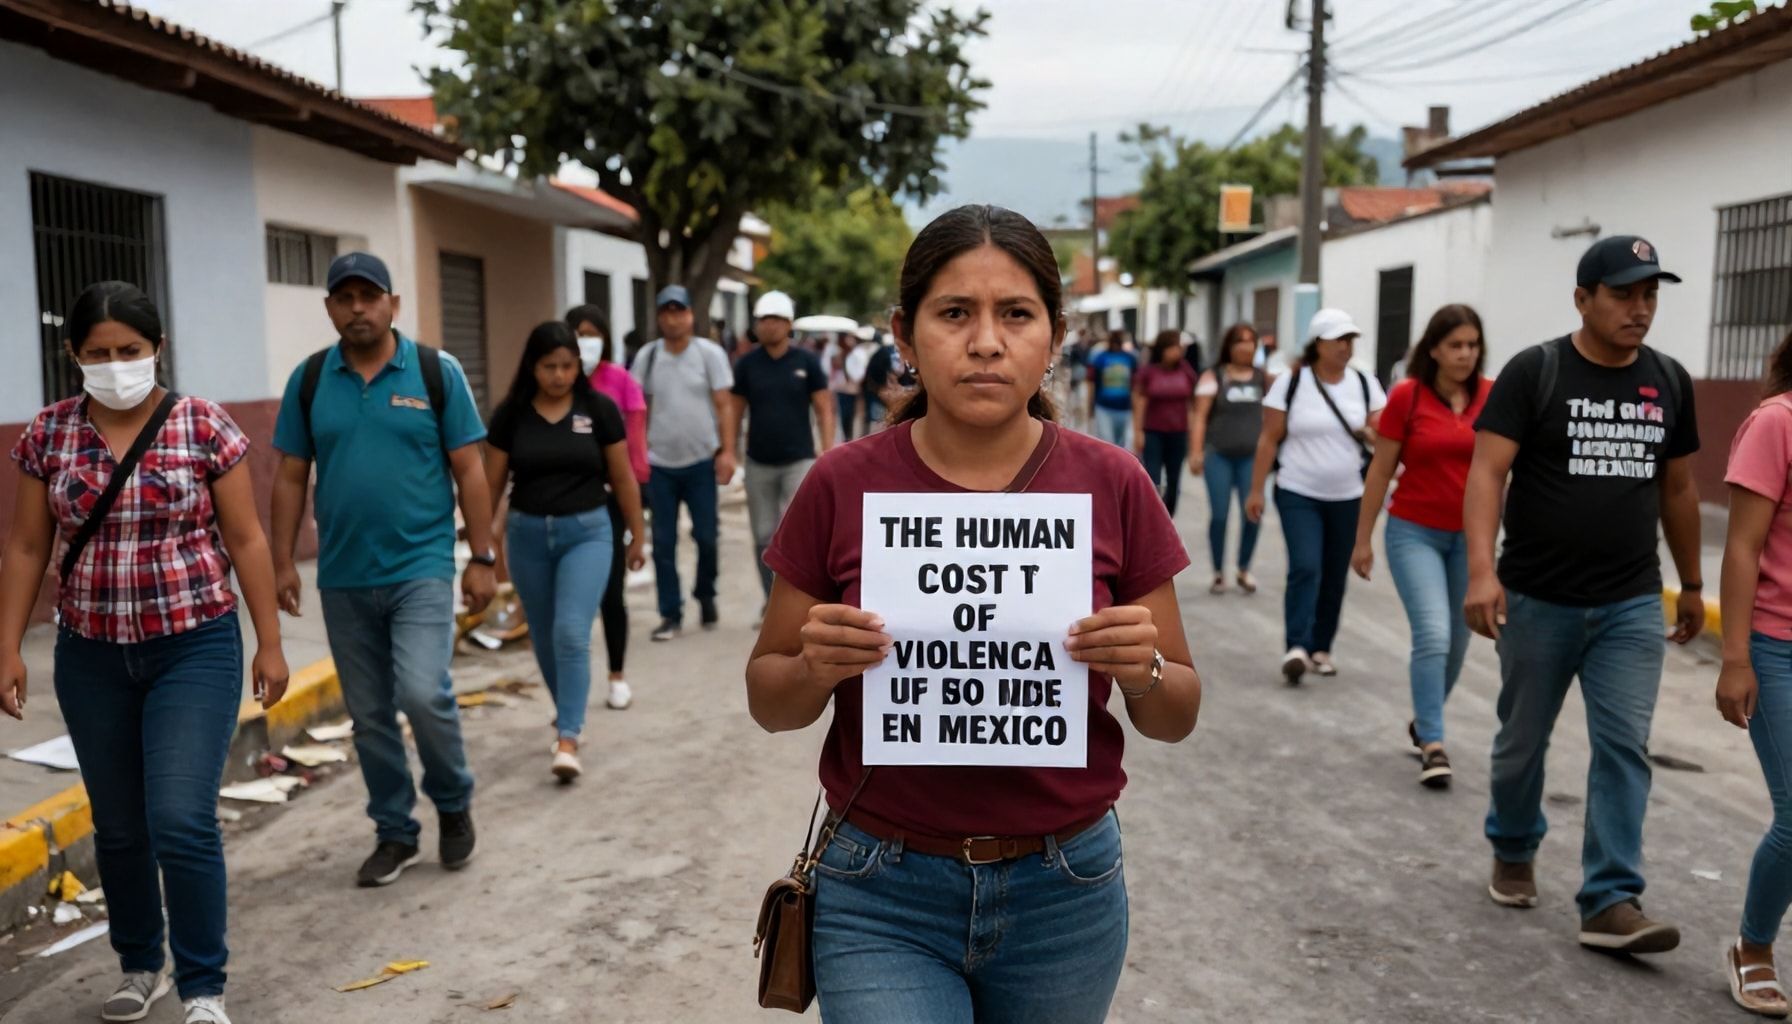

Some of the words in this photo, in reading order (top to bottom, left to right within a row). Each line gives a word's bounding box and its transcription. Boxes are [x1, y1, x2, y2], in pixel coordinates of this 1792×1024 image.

[880, 516, 943, 549] THE
[956, 517, 1075, 549] HUMAN
[918, 563, 1009, 595] COST
[953, 603, 997, 632] OF
[893, 640, 1056, 670] VIOLENCA
[890, 677, 928, 705] UF
[882, 713, 921, 743] EN
[938, 714, 1067, 746] MEXICO
